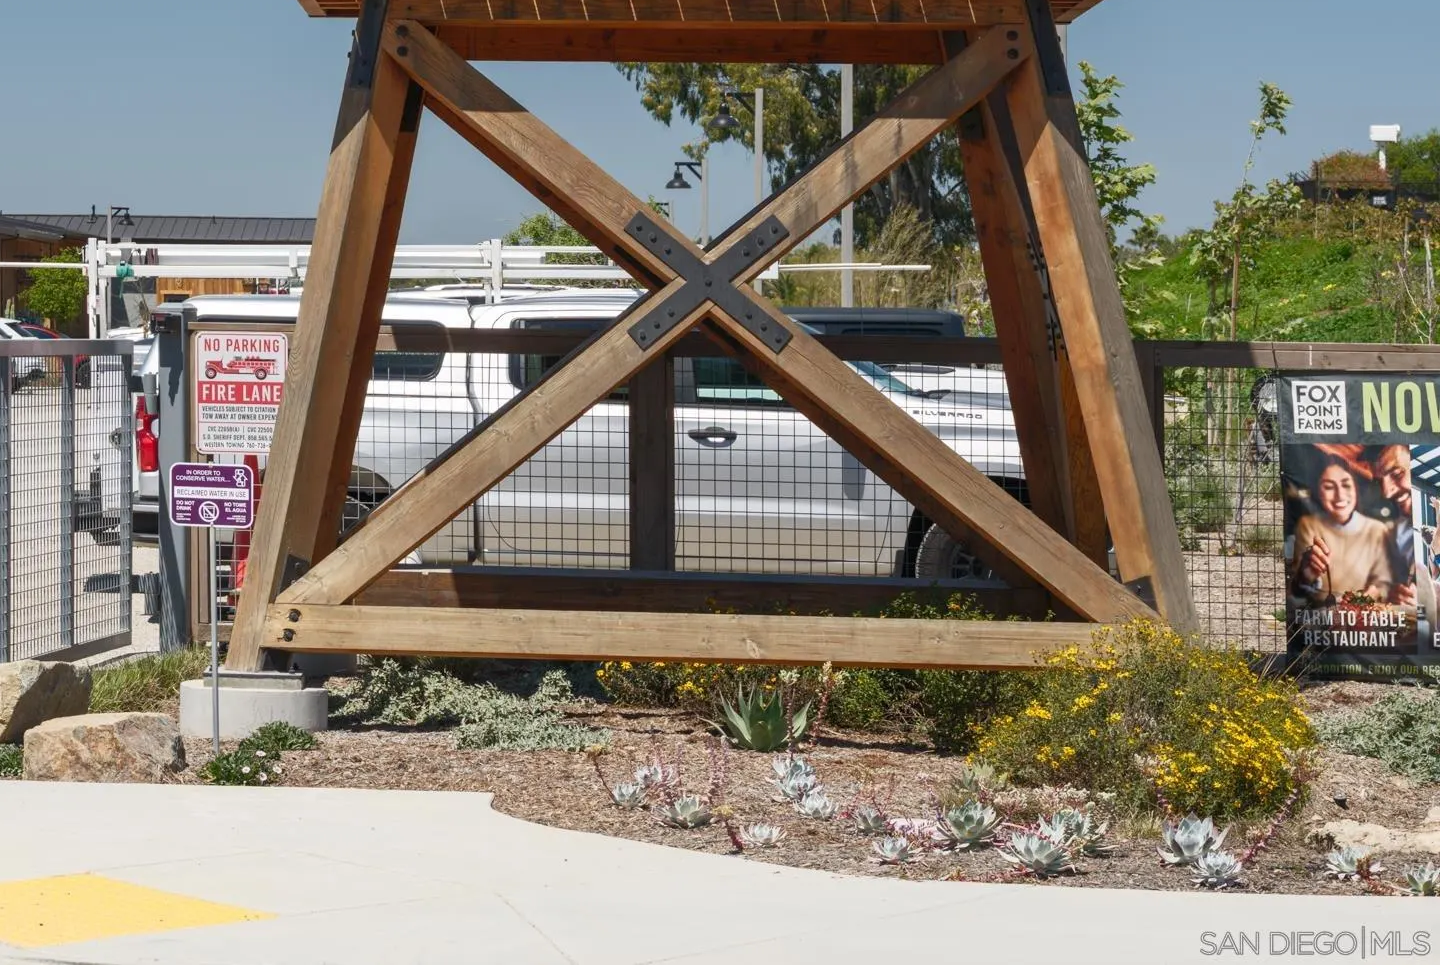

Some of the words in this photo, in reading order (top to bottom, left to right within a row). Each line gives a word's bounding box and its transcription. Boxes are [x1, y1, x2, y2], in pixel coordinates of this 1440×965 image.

[204, 339, 220, 352] NO
[226, 339, 280, 353] PARKING
[202, 384, 236, 401] FIRE
[243, 385, 281, 402] LANE
[1295, 385, 1341, 403] FOX
[913, 410, 983, 419] SILVERADO
[1298, 405, 1342, 417] POINT
[1298, 419, 1343, 430] FARMS
[1295, 609, 1334, 626] FARM
[1338, 611, 1356, 626] TO
[1361, 611, 1406, 628] TABLE
[1304, 630, 1398, 648] RESTAURANT
